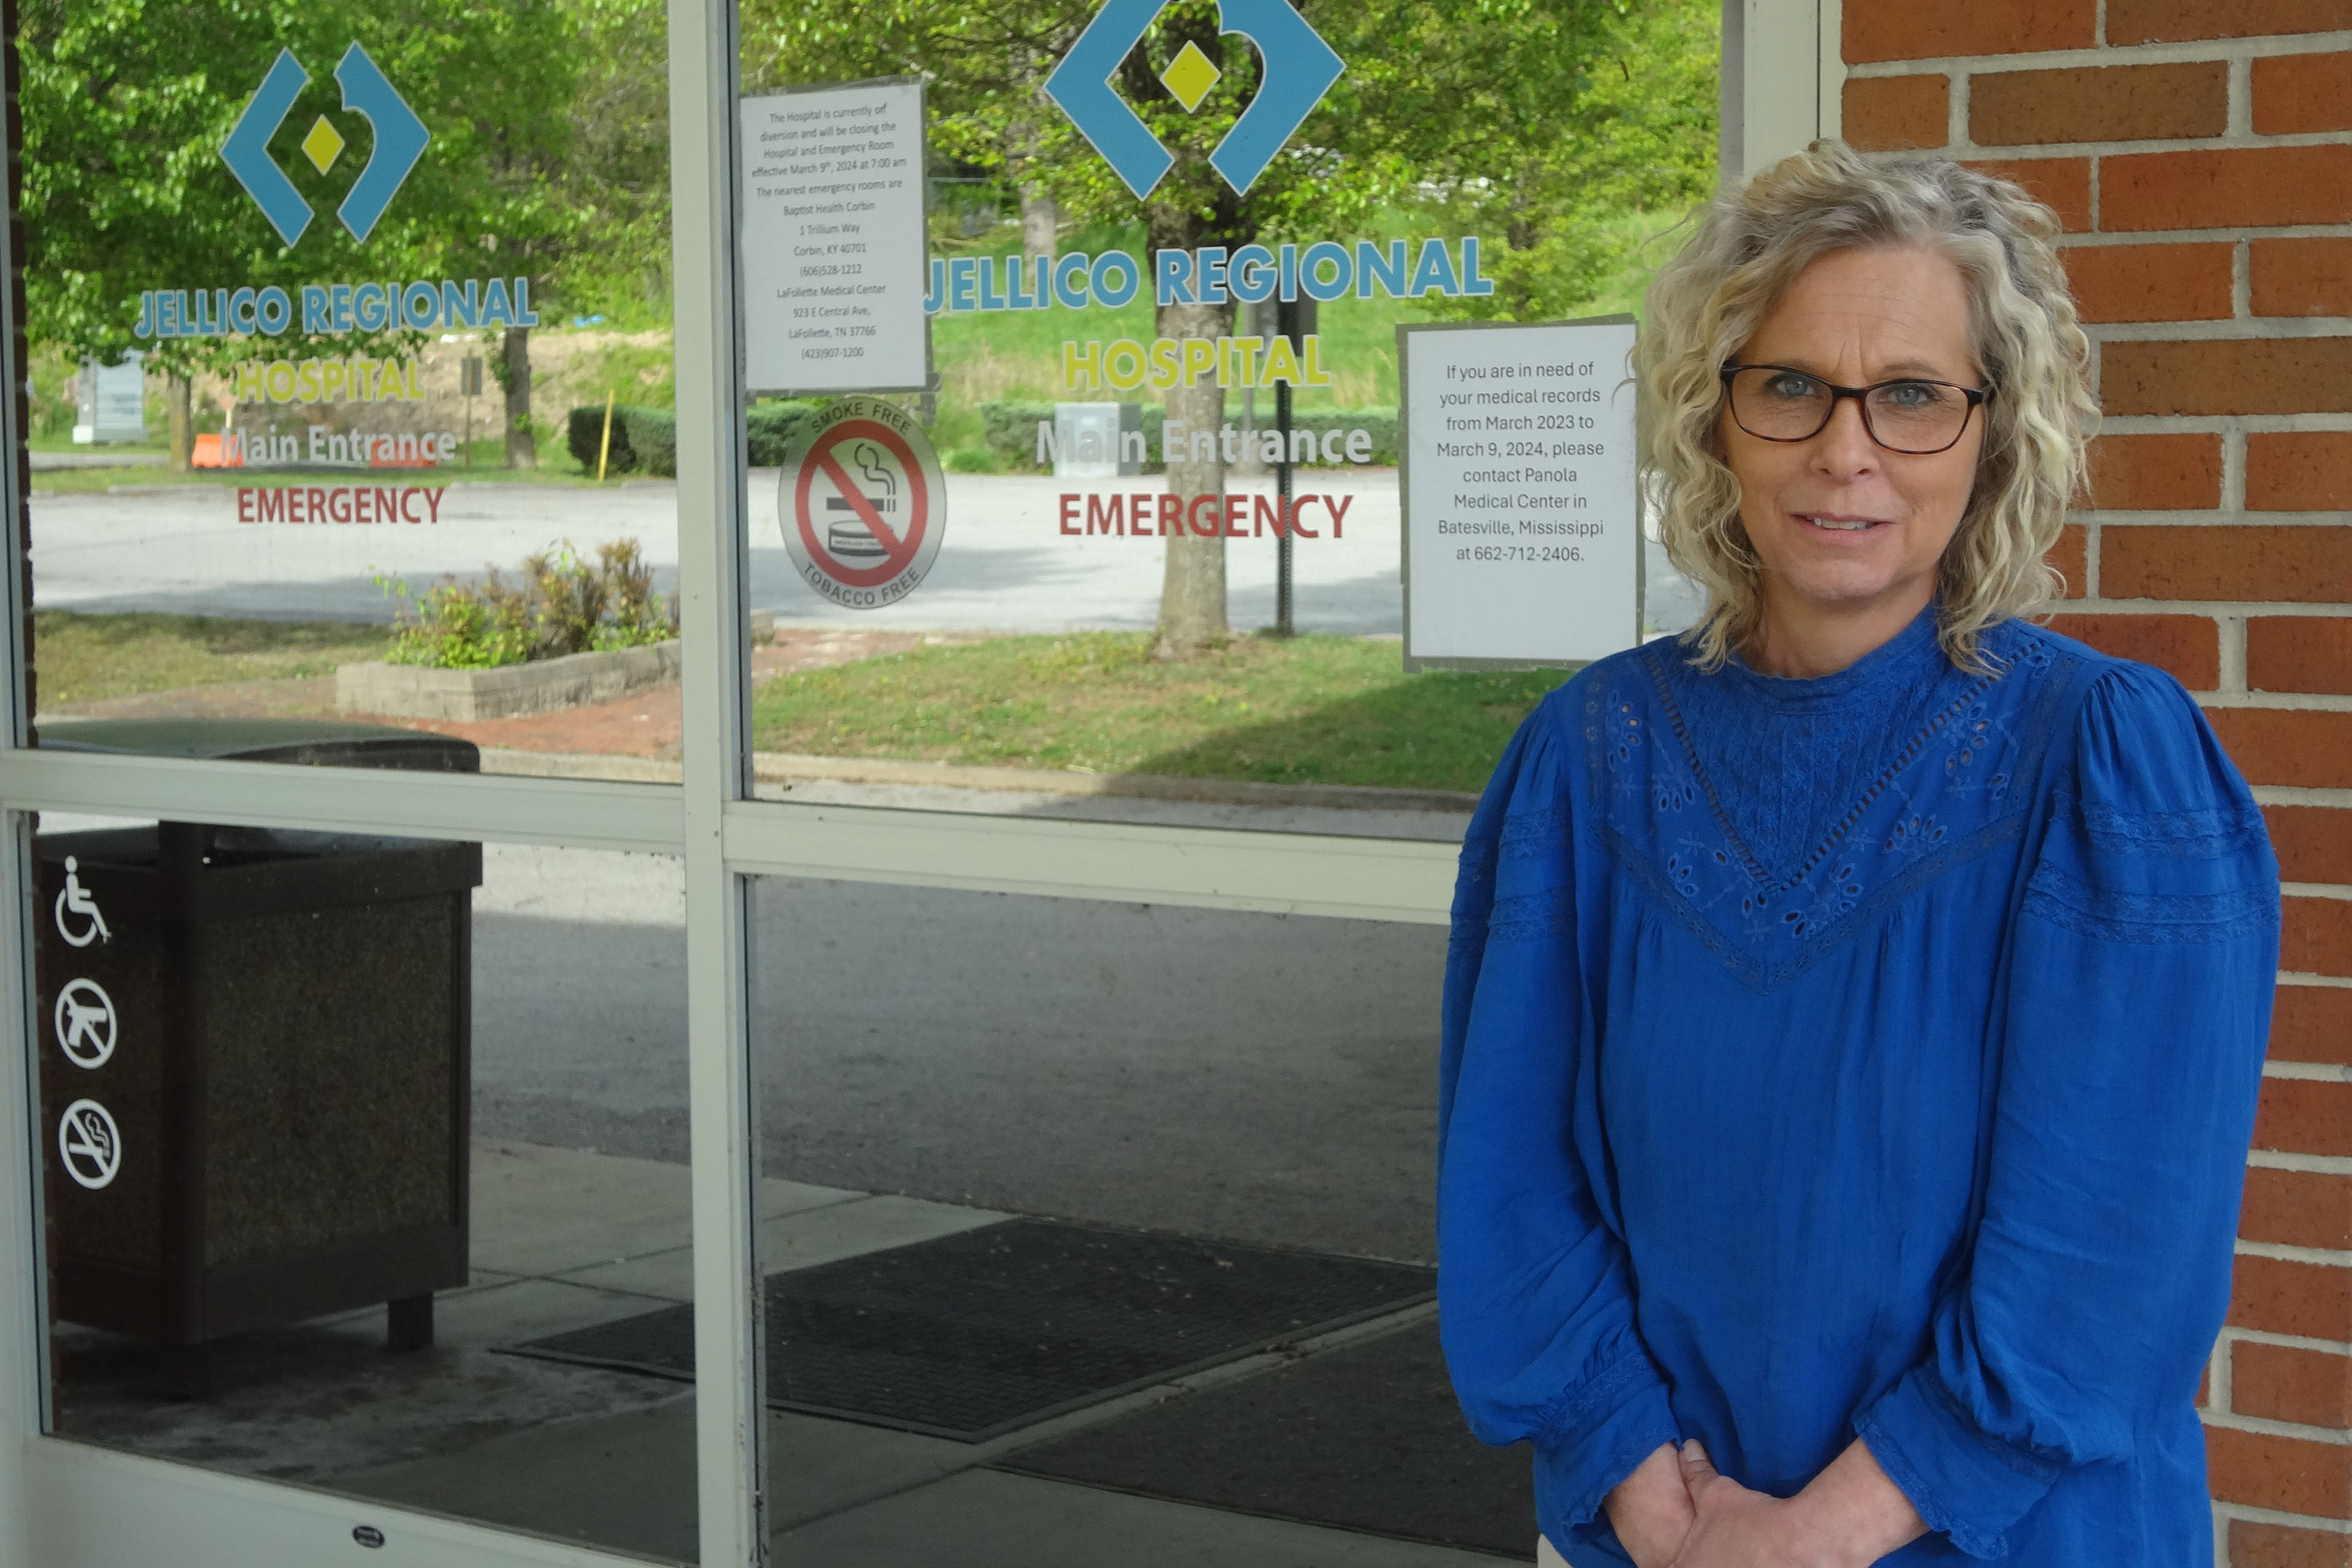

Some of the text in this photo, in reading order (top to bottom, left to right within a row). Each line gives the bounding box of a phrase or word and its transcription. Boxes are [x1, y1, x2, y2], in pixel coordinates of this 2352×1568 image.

[769, 113, 785, 123] The
[787, 110, 821, 122] Hospital
[824, 110, 831, 119] is
[833, 105, 872, 118] currently
[760, 123, 897, 141] diversion and will be closing the
[764, 140, 894, 159] Hospital and Emergency Room
[752, 166, 788, 177] effective
[790, 164, 818, 174] March
[836, 160, 858, 172] 2024
[860, 160, 869, 169] at
[871, 158, 891, 168] 7:00
[757, 187, 772, 197] The
[774, 186, 806, 196] nearest
[809, 183, 856, 194] emergency
[858, 180, 886, 190] rooms
[783, 201, 875, 217] Baptist Health Corbin
[800, 223, 860, 235] 1 Trillium Way
[793, 243, 867, 257] Corbin, KY 40701
[923, 235, 1494, 314] JELLICO REGIONAL
[777, 284, 886, 298] LaFollette Medical Center
[134, 276, 539, 339] JELLICO REGIONAL
[793, 307, 809, 318] 923
[812, 307, 816, 317] E
[819, 306, 850, 317] Central
[788, 325, 876, 339] LaFollette, TN 37766
[1063, 334, 1332, 391] HOSPITAL
[1447, 361, 1594, 382] If you are in need of
[236, 358, 426, 405] HOSPITAL
[1439, 388, 1600, 408] your medical records
[812, 401, 911, 435] SMOKE FREE
[1447, 415, 1594, 431] from March 2023 to
[221, 424, 456, 462] Main Entrance
[1036, 420, 1373, 465] Main Entrance
[1437, 440, 1604, 459] March 9, 2024, please
[1463, 467, 1577, 482] contact Panola
[237, 487, 445, 524] EMERGENCY
[1454, 493, 1587, 508] Medical Center in
[1059, 493, 1354, 538] EMERGENCY
[1438, 520, 1604, 538] Batesville, Mississippi
[1457, 546, 1584, 561] at 662-712-2406.
[804, 561, 919, 605] TOBACCO FREE
